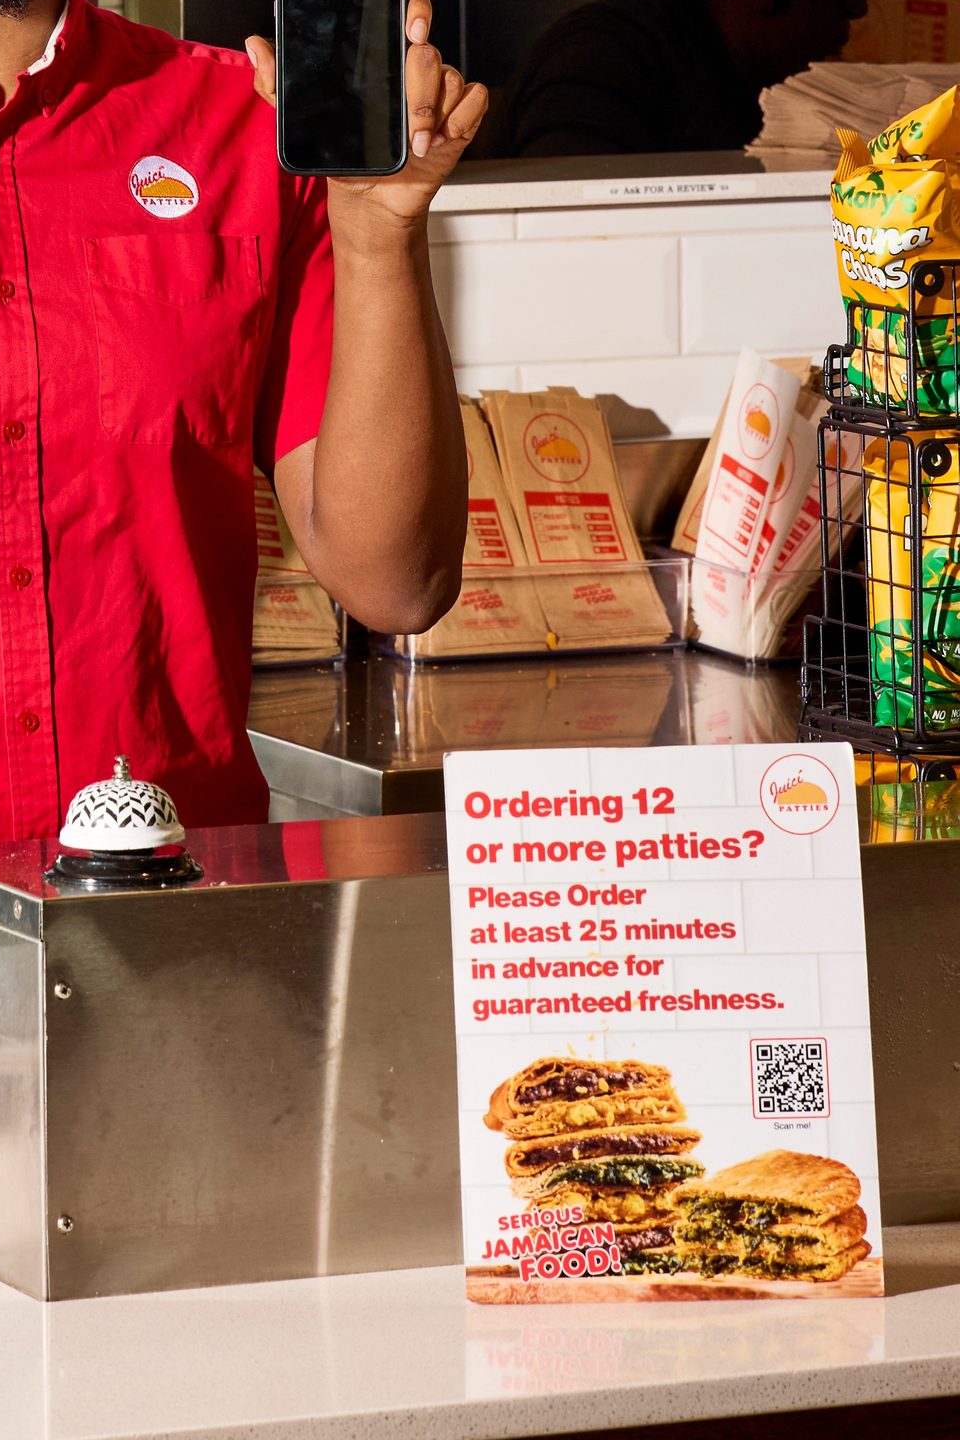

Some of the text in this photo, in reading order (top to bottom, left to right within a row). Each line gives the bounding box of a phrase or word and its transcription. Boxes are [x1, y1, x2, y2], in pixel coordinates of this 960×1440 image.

[142, 198, 194, 206] PATTIES
[623, 186, 641, 195] Ask
[644, 186, 664, 194] FOR
[677, 184, 716, 193] REVIEW
[841, 248, 909, 293] Chips
[932, 710, 946, 720] NO
[464, 787, 675, 824] Ordering 12
[778, 803, 830, 813] PATTIES
[465, 830, 765, 867] or more patties?
[468, 882, 647, 909] Please Order
[470, 917, 737, 945] at least 25 minutes
[471, 954, 665, 980] in advance for
[472, 988, 785, 1022] guaranteed freshness.
[773, 1120, 812, 1130] Scan me!
[517, 1250, 622, 1284] FOOD!
